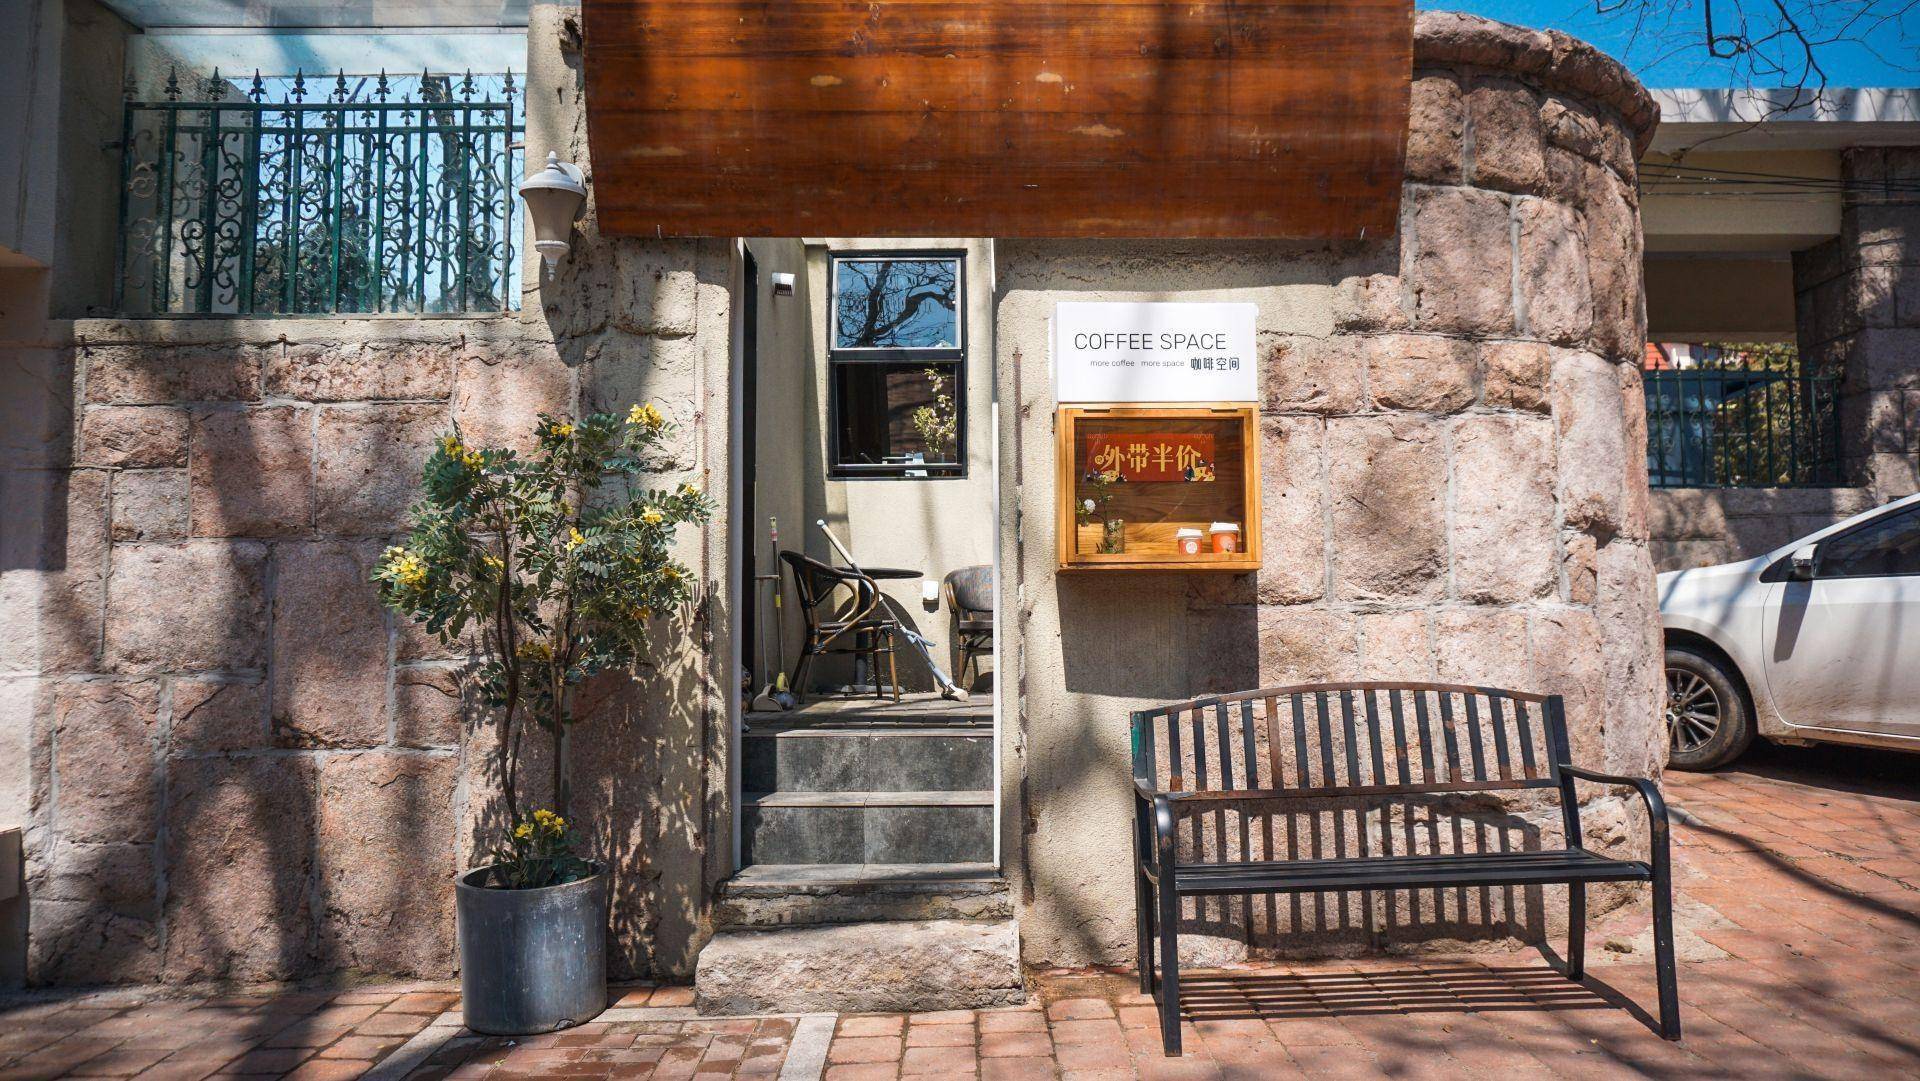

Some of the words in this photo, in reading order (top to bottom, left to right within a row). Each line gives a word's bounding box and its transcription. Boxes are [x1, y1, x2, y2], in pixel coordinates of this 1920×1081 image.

[1074, 333, 1154, 350] COFFEE
[1160, 333, 1227, 350] SPACE
[1111, 359, 1135, 367] coffee
[1162, 360, 1185, 368] space
[1190, 357, 1240, 371] 咖啡空间
[1098, 443, 1202, 473] 外带半价
